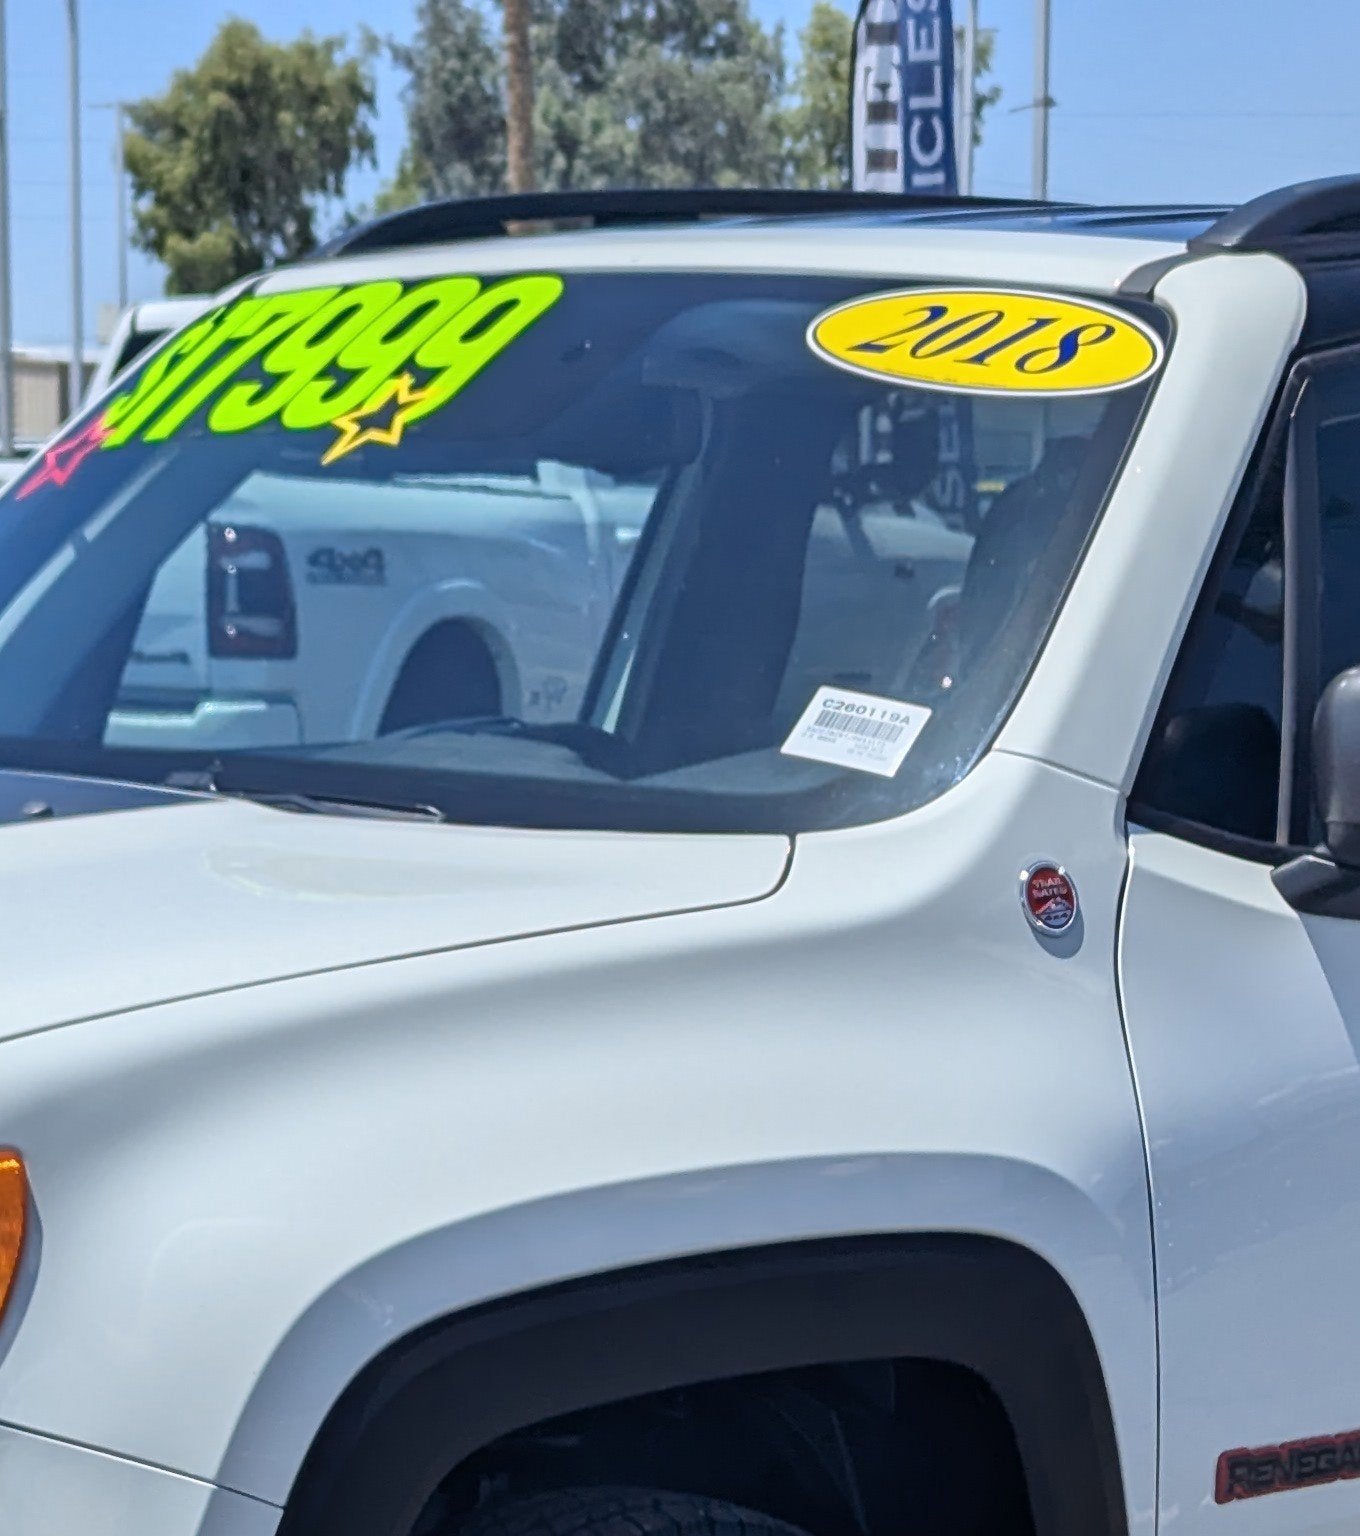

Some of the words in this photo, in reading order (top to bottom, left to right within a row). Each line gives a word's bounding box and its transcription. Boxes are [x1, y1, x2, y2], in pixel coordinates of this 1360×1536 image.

[99, 274, 564, 452] $17999
[848, 304, 1117, 375] 2018
[822, 698, 911, 726] C260119A
